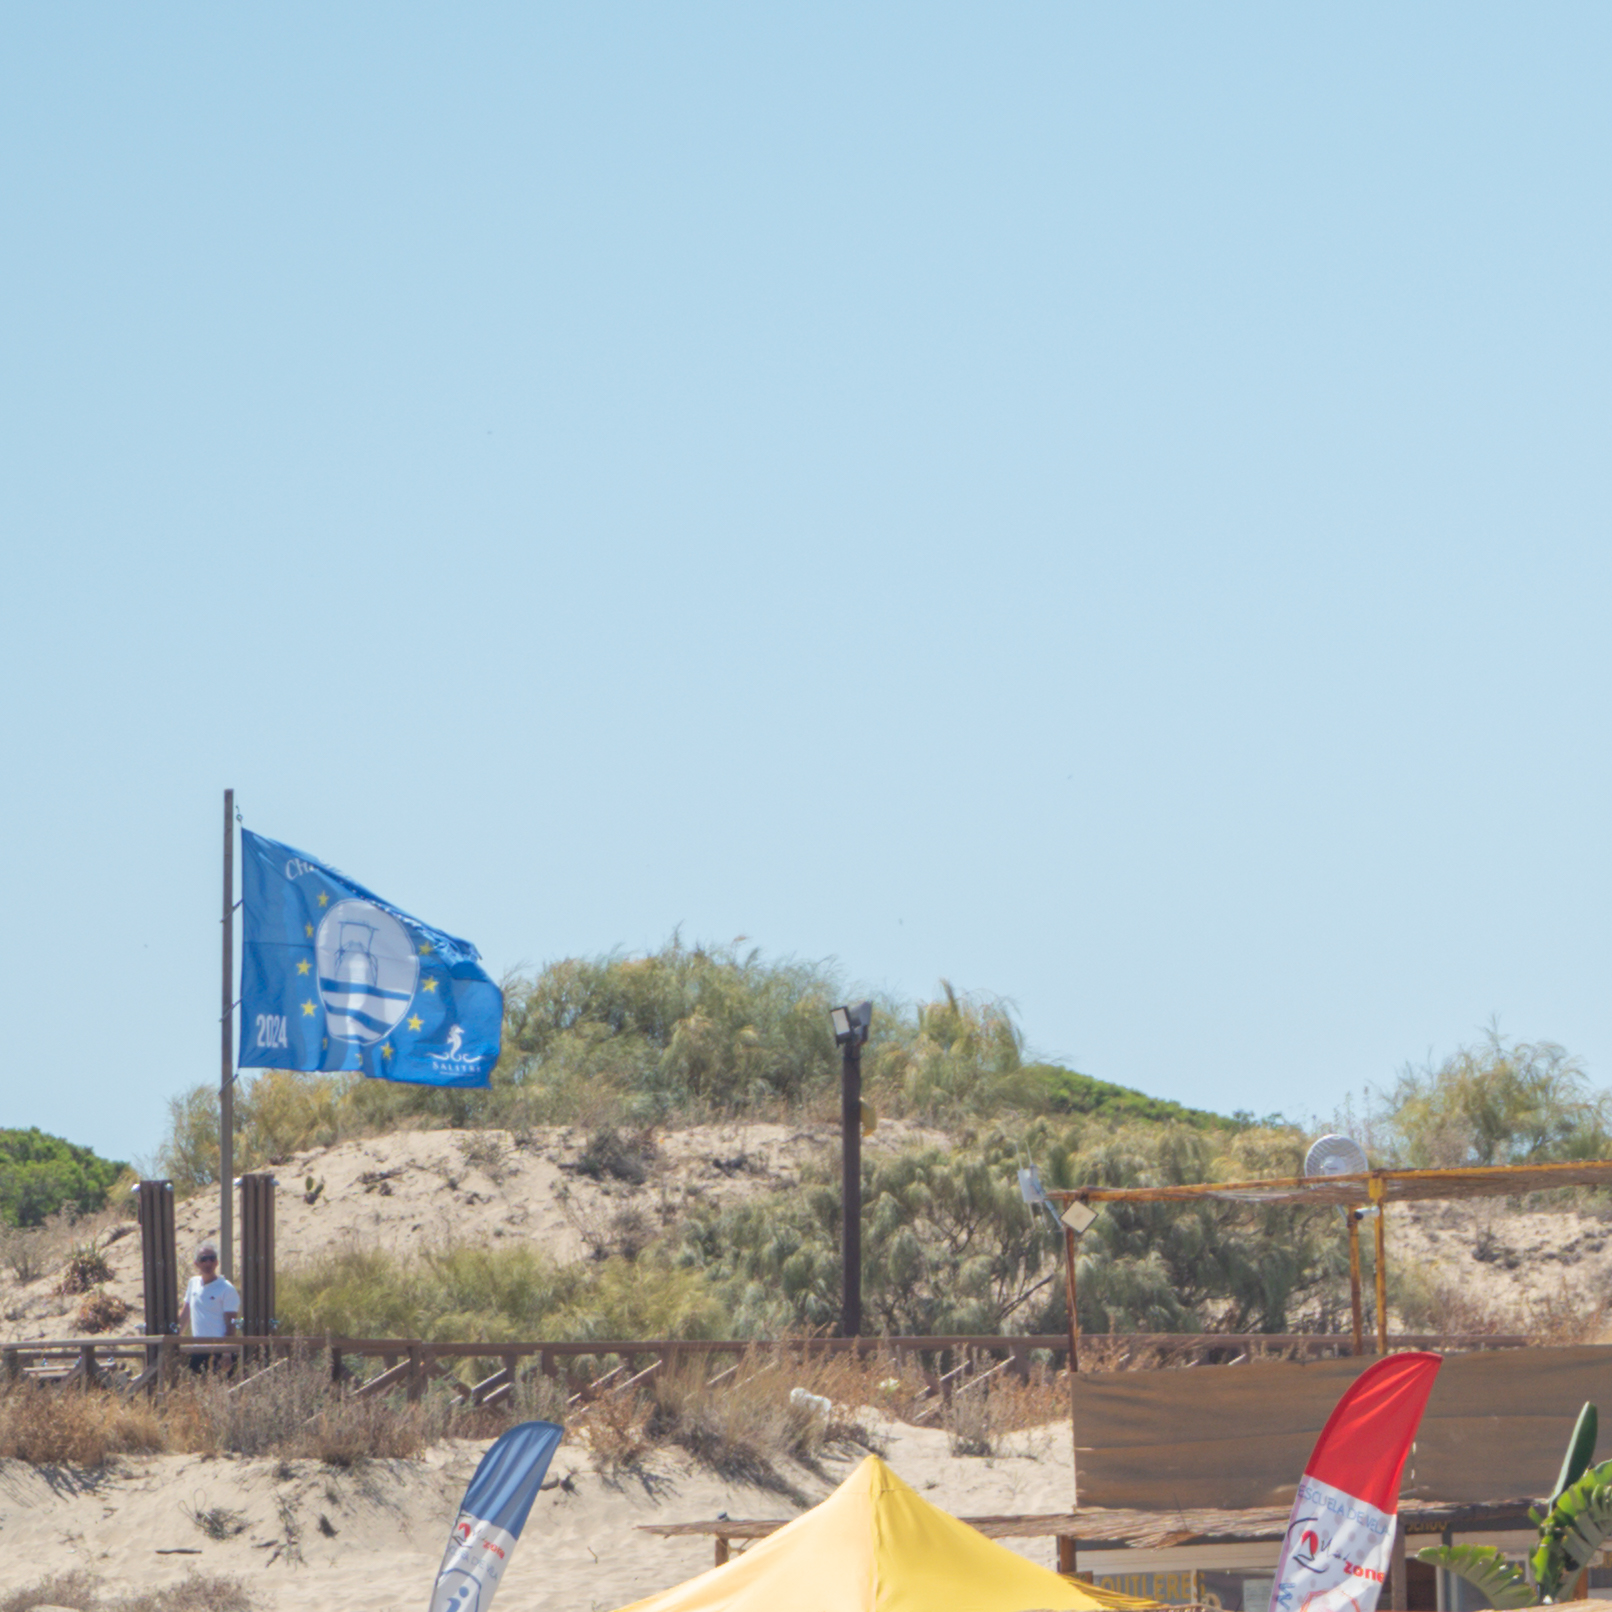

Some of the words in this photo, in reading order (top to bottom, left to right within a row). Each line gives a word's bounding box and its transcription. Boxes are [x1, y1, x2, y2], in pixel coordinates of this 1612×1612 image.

[256, 1014, 288, 1048] 2024
[1298, 1484, 1345, 1518] ESCUELA
[1347, 1507, 1364, 1525] DE
[1343, 1560, 1386, 1584] zone
